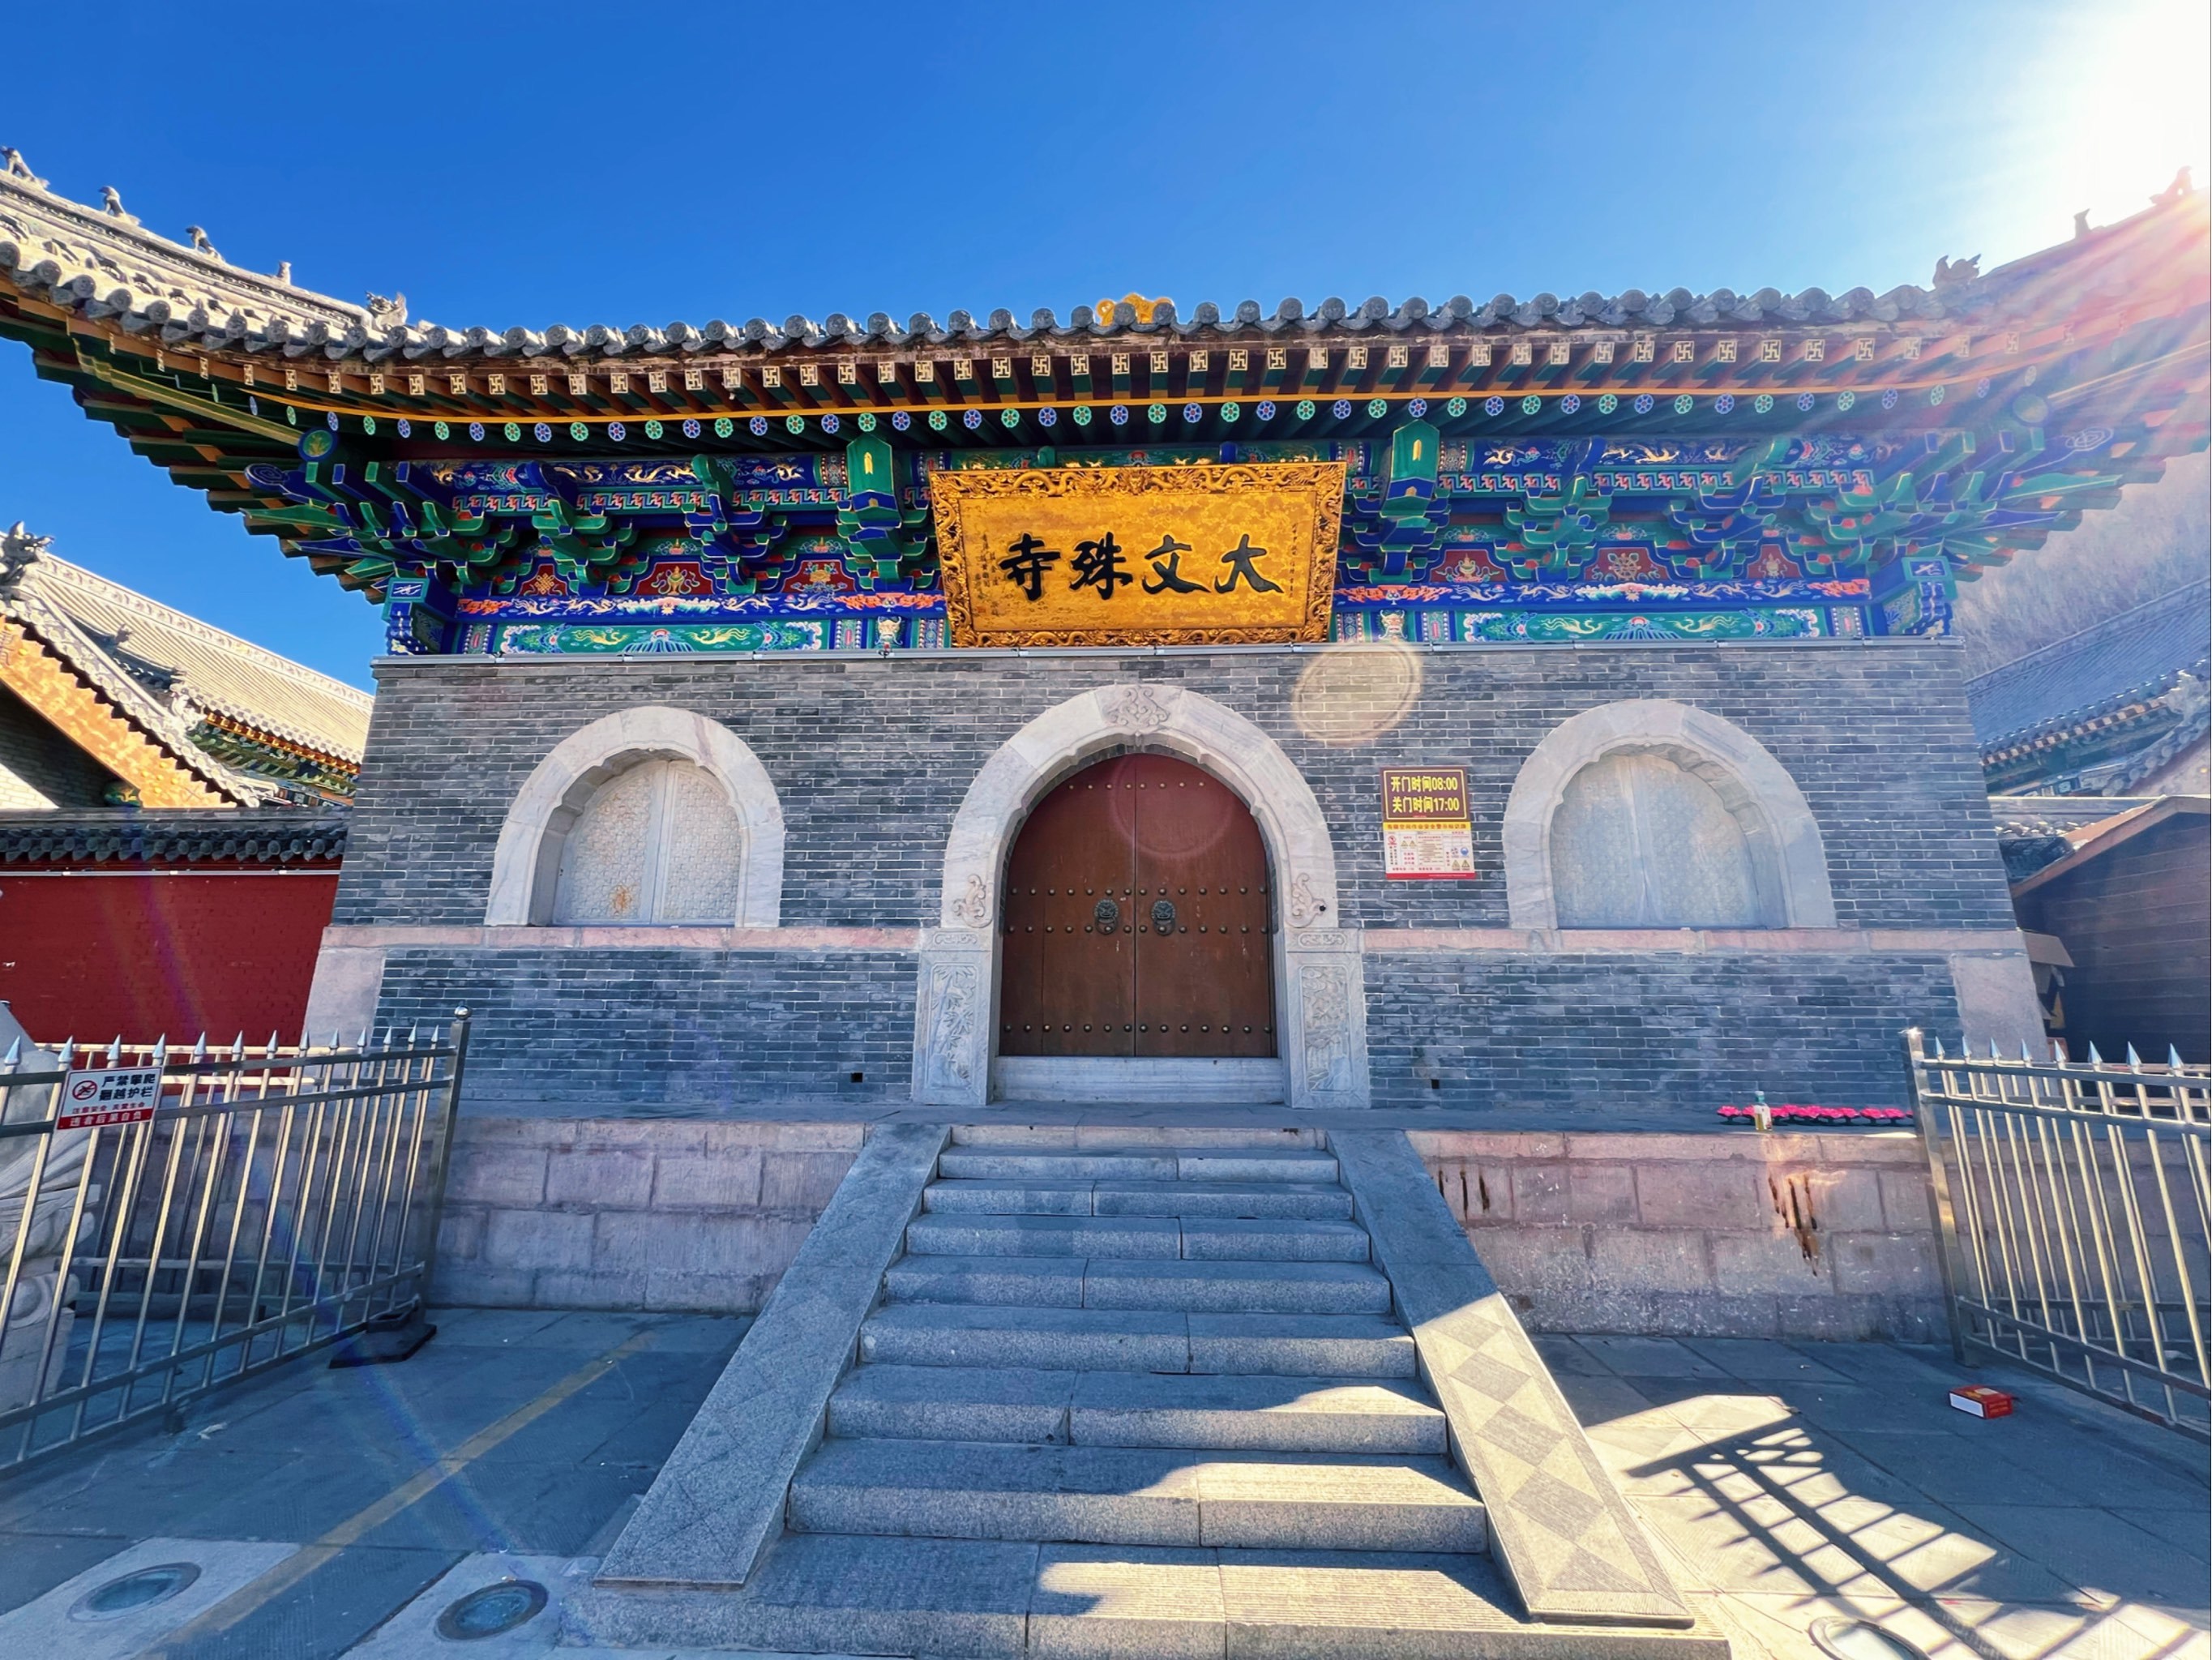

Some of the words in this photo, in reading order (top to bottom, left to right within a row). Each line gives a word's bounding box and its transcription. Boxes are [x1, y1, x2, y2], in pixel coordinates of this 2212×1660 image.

[999, 531, 1284, 601] 大文殊寺
[1390, 776, 1458, 793] 开门时间08:00
[1393, 796, 1460, 813] 关门时间17:00
[101, 1073, 156, 1087] 严禁攀爬
[99, 1086, 153, 1102] 翻越护栏
[70, 1111, 142, 1127] 违者后果自负
